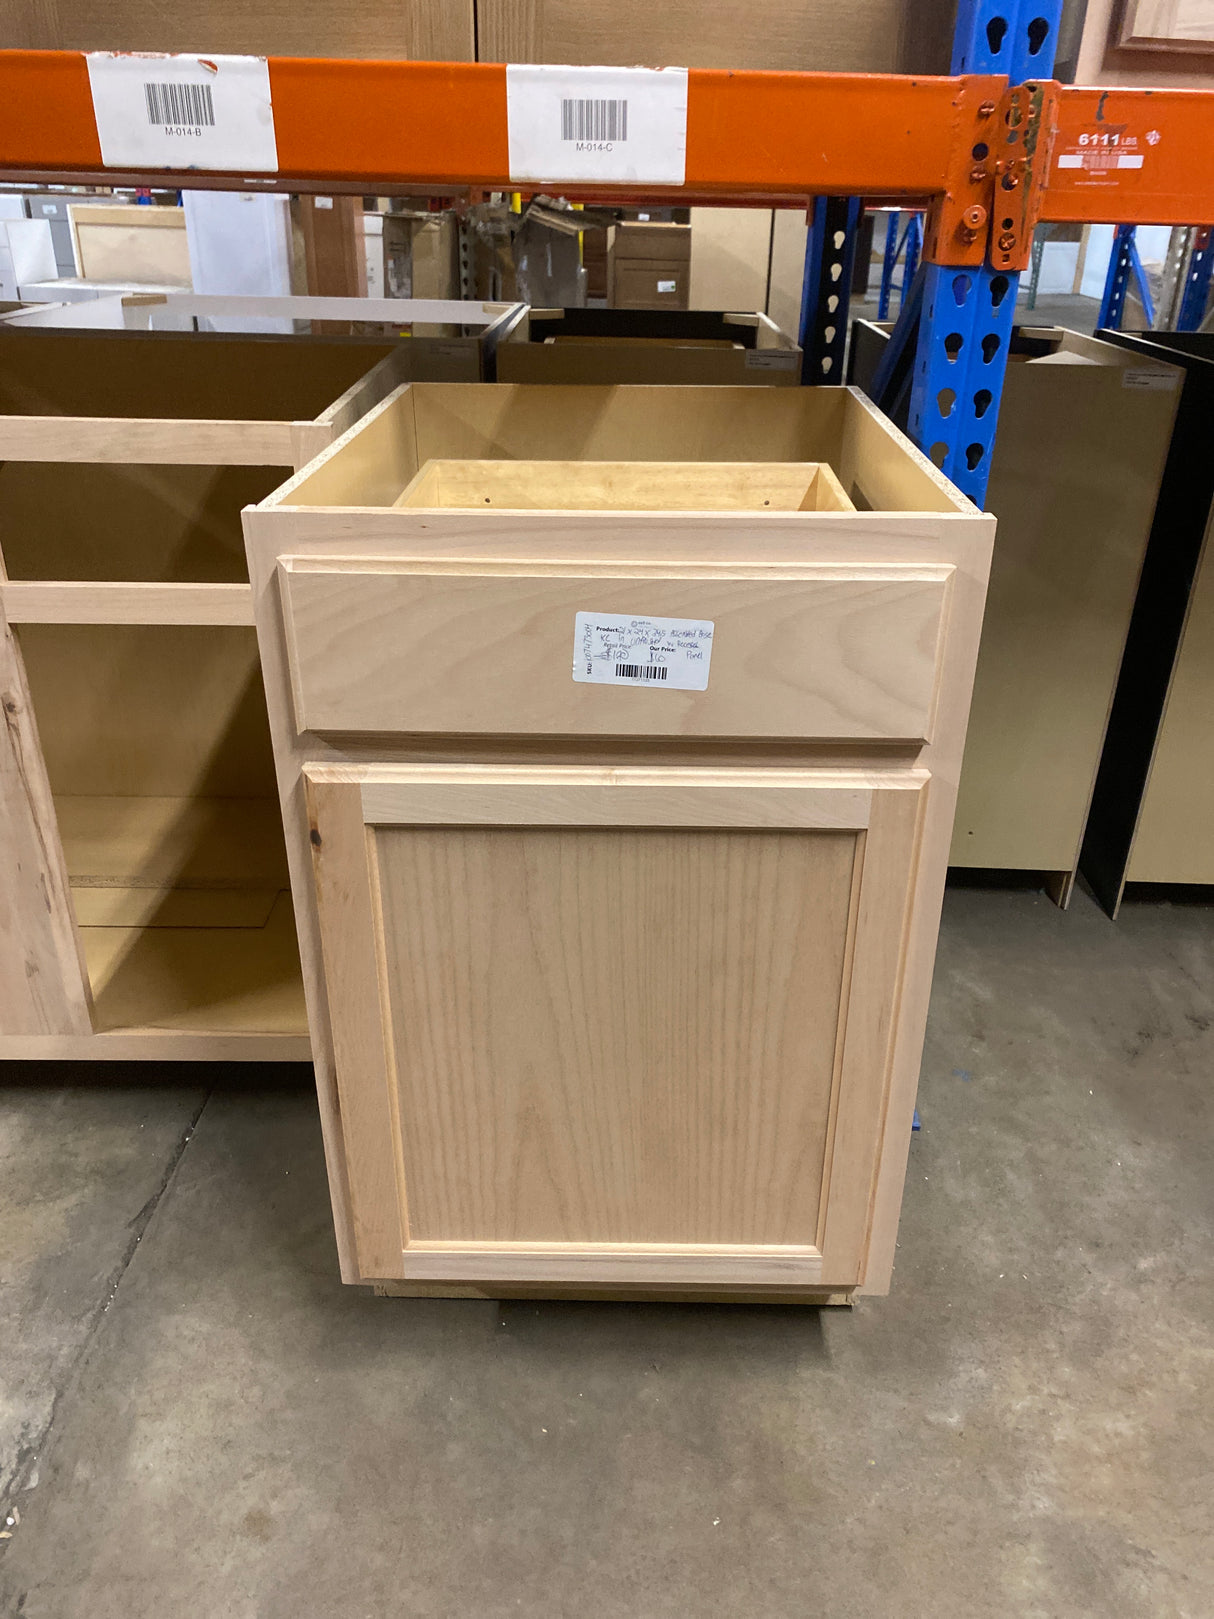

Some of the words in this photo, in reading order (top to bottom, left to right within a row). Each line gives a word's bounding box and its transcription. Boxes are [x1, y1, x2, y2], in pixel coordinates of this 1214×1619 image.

[165, 126, 202, 137] M-014-B
[1078, 133, 1120, 146] 6111
[1121, 137, 1138, 146] LBS
[575, 142, 613, 152] M-014-C
